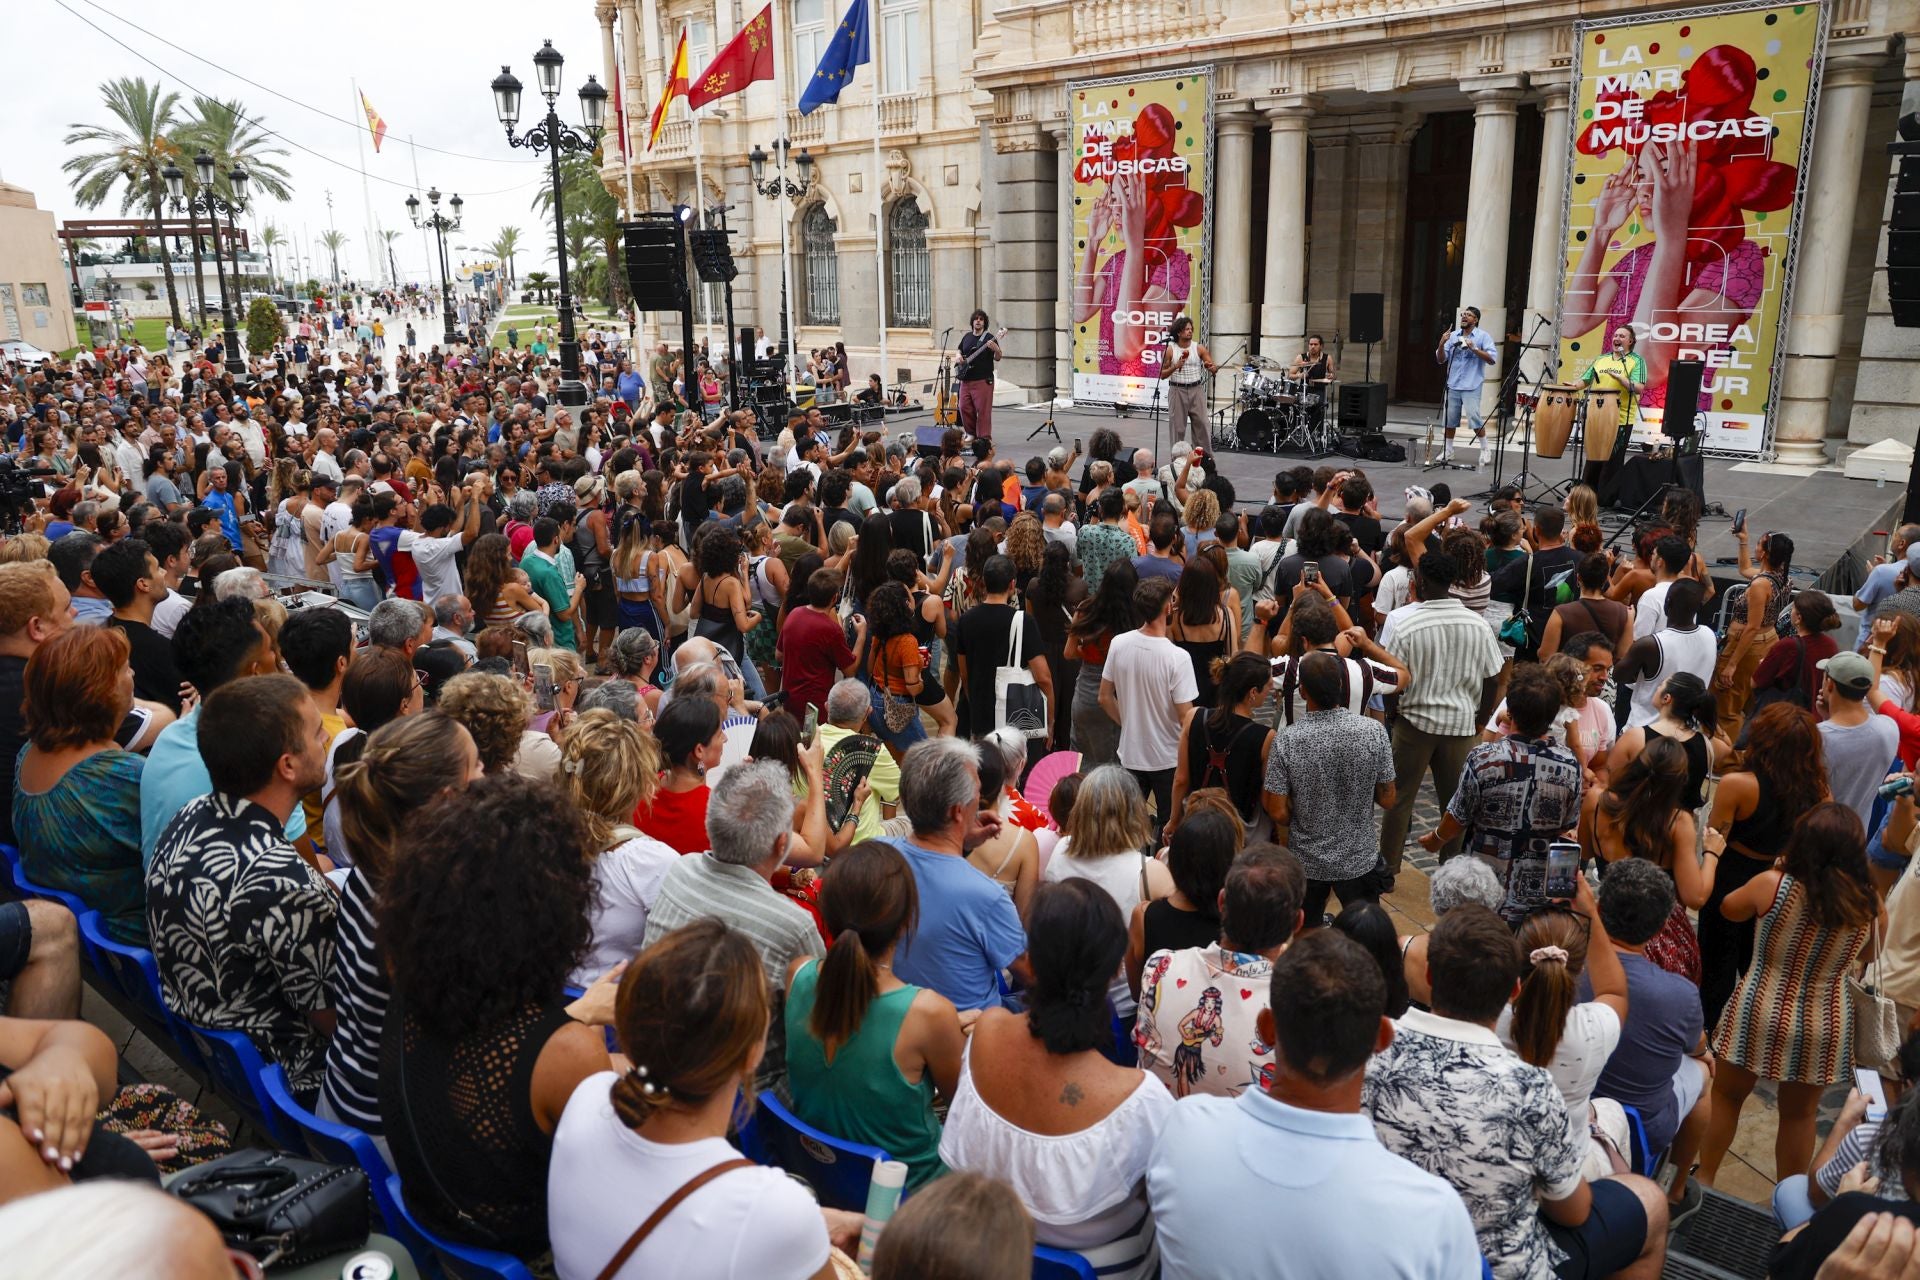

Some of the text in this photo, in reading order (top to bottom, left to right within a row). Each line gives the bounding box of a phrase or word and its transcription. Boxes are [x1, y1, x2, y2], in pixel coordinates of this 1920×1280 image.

[1598, 45, 1642, 68] LA
[1595, 69, 1680, 94] MAR
[1082, 101, 1109, 116] LA
[1593, 100, 1644, 121] DE
[1082, 119, 1132, 137] MAR
[1590, 116, 1772, 149] MÚSICAS
[1082, 141, 1113, 158] DE
[1082, 157, 1187, 178] MÚSICAS
[1628, 322, 1754, 343] COREA
[1700, 375, 1749, 395] UR
